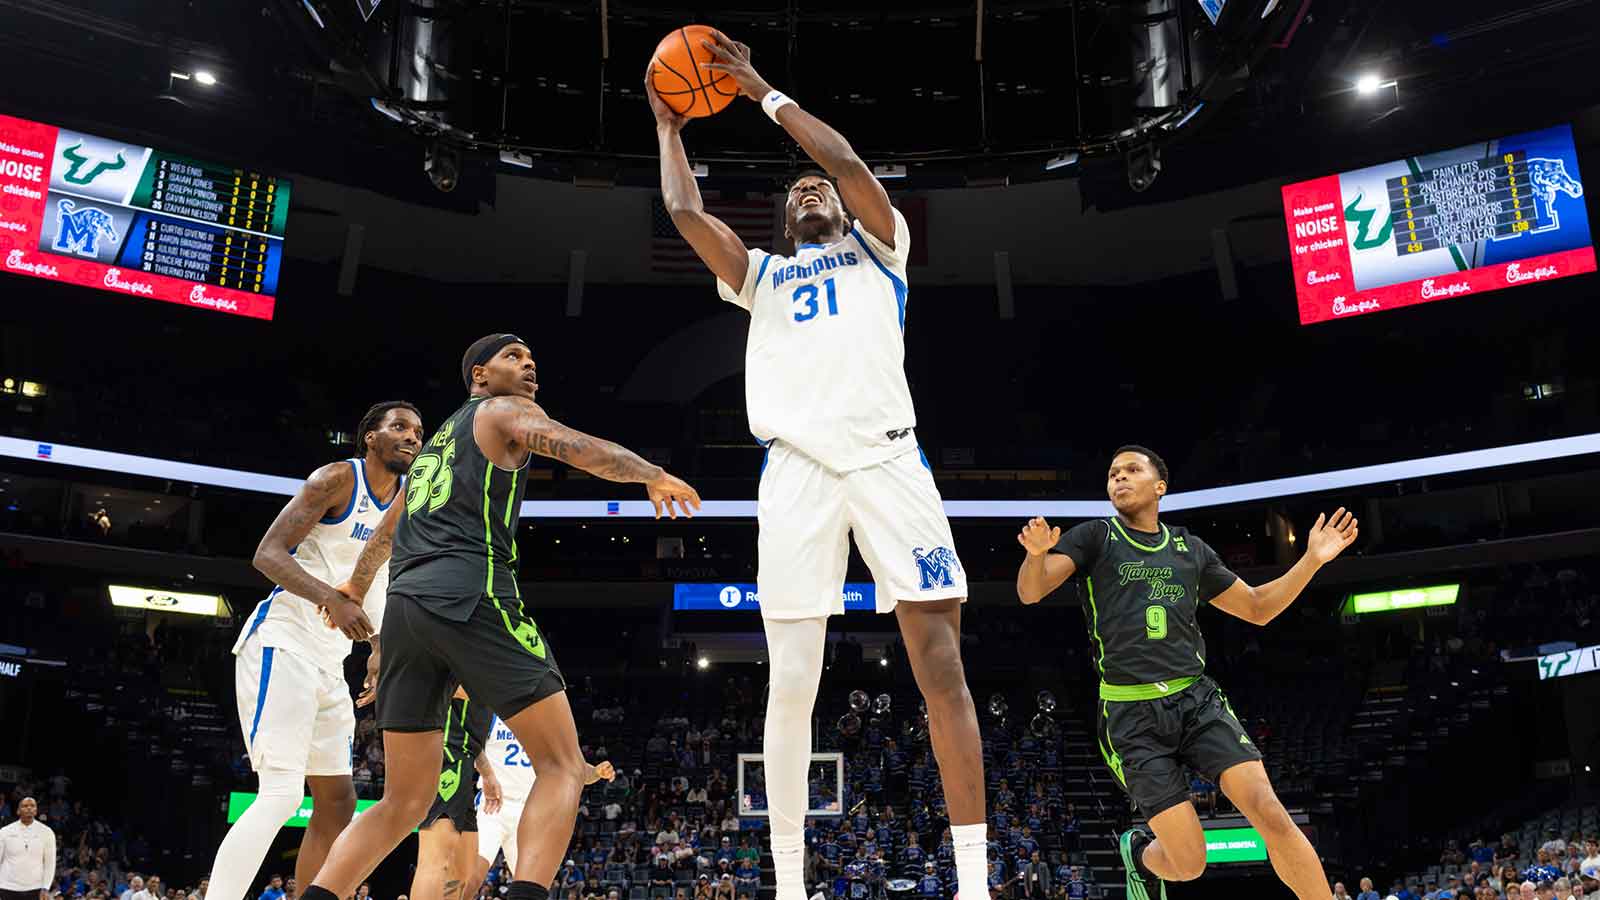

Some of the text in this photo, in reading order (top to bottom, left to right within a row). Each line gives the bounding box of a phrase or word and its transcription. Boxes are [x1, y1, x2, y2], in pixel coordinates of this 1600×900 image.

[22, 149, 44, 159] some
[161, 160, 167, 169] 2
[1432, 164, 1459, 178] PAINT
[1461, 160, 1479, 173] PTS
[1504, 154, 1514, 164] 10
[3, 184, 41, 199] chicken
[192, 178, 213, 190] JONES
[1420, 182, 1438, 195] 2ND
[1440, 173, 1477, 192] CHANCE
[1479, 169, 1496, 181] PTS
[1424, 186, 1477, 205] FASTBREAK
[1477, 181, 1495, 194] PTS
[1436, 199, 1468, 214] BENCH
[1469, 193, 1487, 206] PTS
[191, 208, 218, 221] NELSON
[1293, 202, 1334, 217] Make some
[1424, 215, 1439, 228] PTS
[1440, 212, 1455, 225] OFF
[1456, 202, 1503, 222] TURNOVERS
[1295, 216, 1339, 238] NOISE
[1432, 221, 1472, 239] LARGEST
[1473, 215, 1497, 229] LEAD
[1439, 234, 1460, 247] TIME
[1461, 232, 1469, 243] IN
[1471, 227, 1496, 242] LEAD
[1296, 238, 1344, 255] for chicken
[144, 252, 154, 261] 23
[156, 254, 182, 267] SINCERE
[184, 258, 210, 271] PARKER
[144, 262, 151, 271] 31
[154, 264, 183, 277] THIERNO
[184, 270, 205, 281] SYLLA
[772, 251, 858, 290] Memphis
[792, 277, 839, 322] 31
[1119, 560, 1173, 586] Tampa
[1149, 580, 1185, 603] Bay
[1146, 605, 1168, 640] 9
[0, 662, 22, 678] HALF
